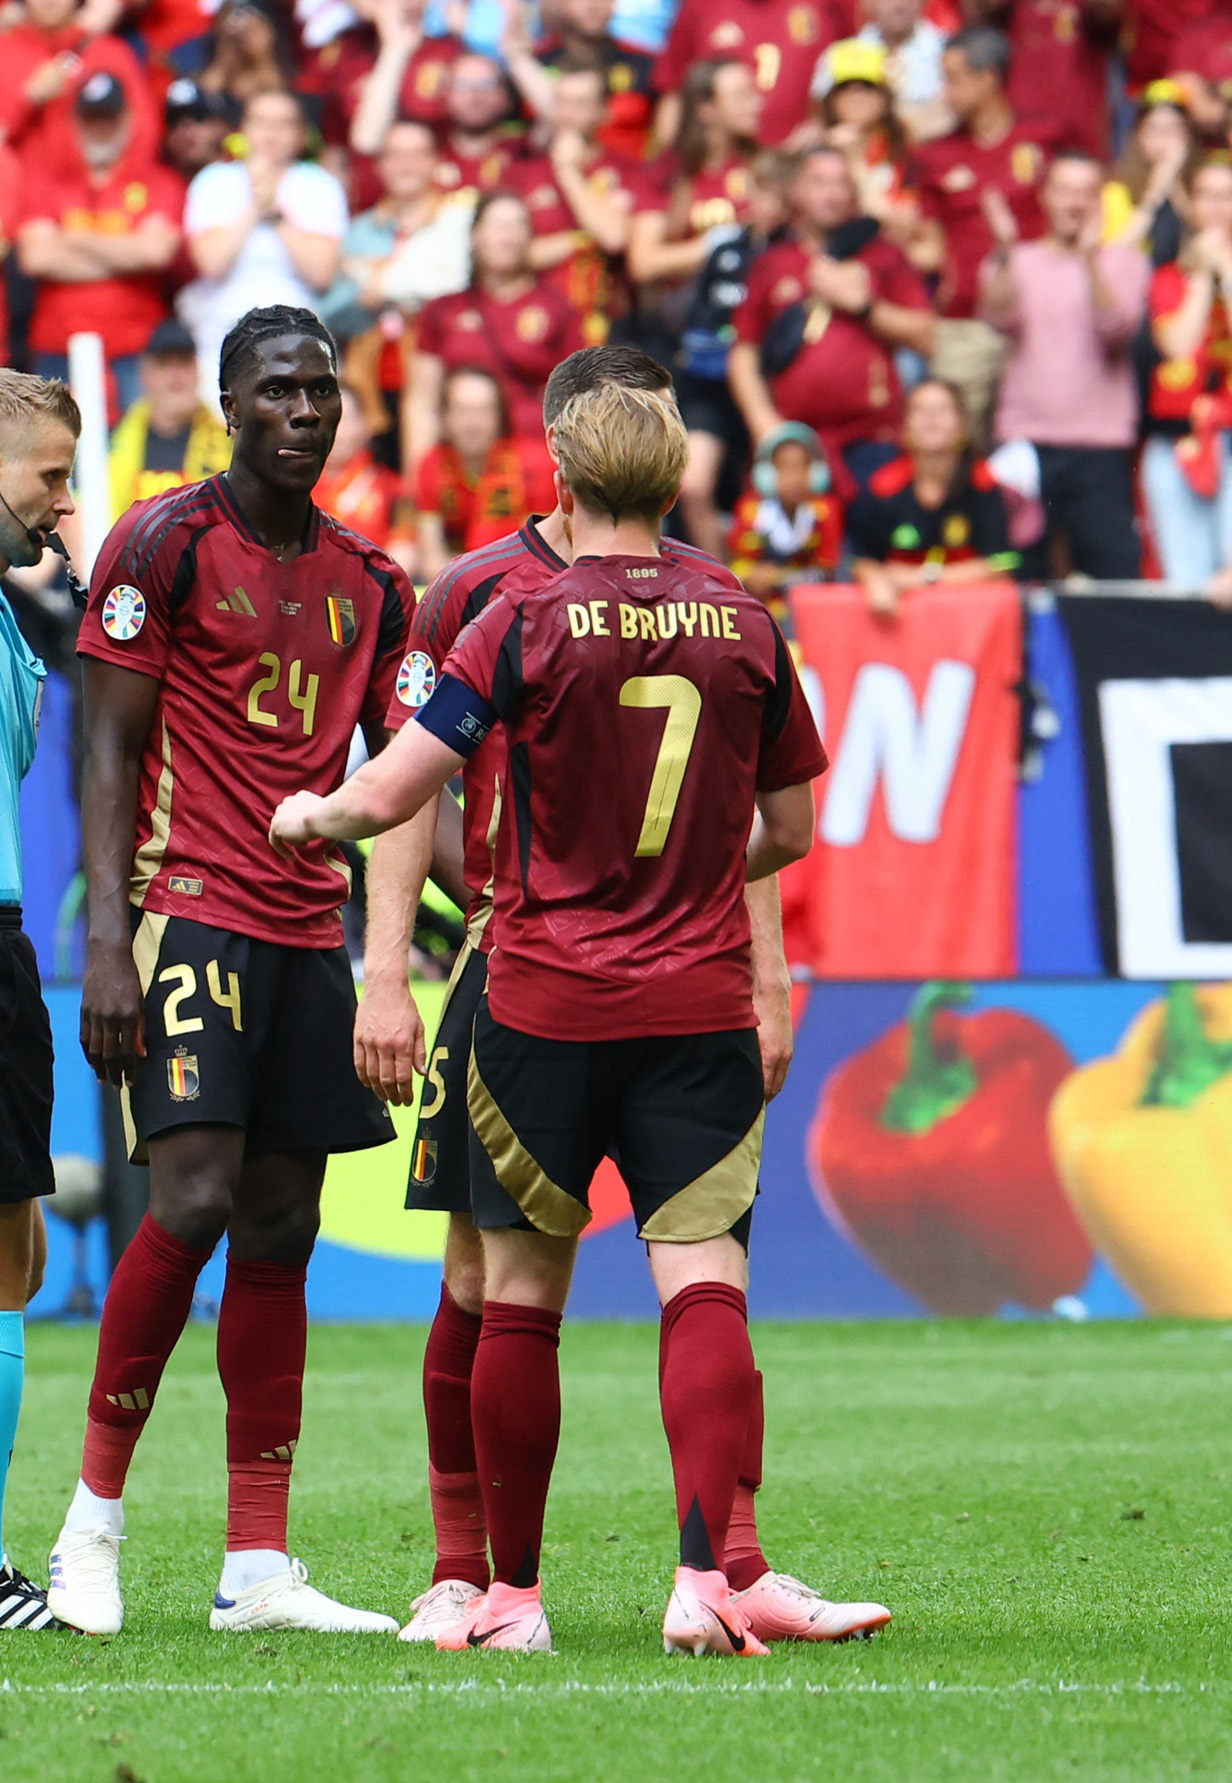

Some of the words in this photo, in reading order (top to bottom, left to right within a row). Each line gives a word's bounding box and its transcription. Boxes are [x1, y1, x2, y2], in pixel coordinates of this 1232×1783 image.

[625, 568, 658, 579] 1895
[567, 601, 611, 639] DE
[618, 602, 742, 641] BRUYNE
[247, 652, 320, 736] 24
[619, 674, 702, 858] 7
[158, 959, 243, 1038] 24
[419, 1046, 449, 1119] 5
